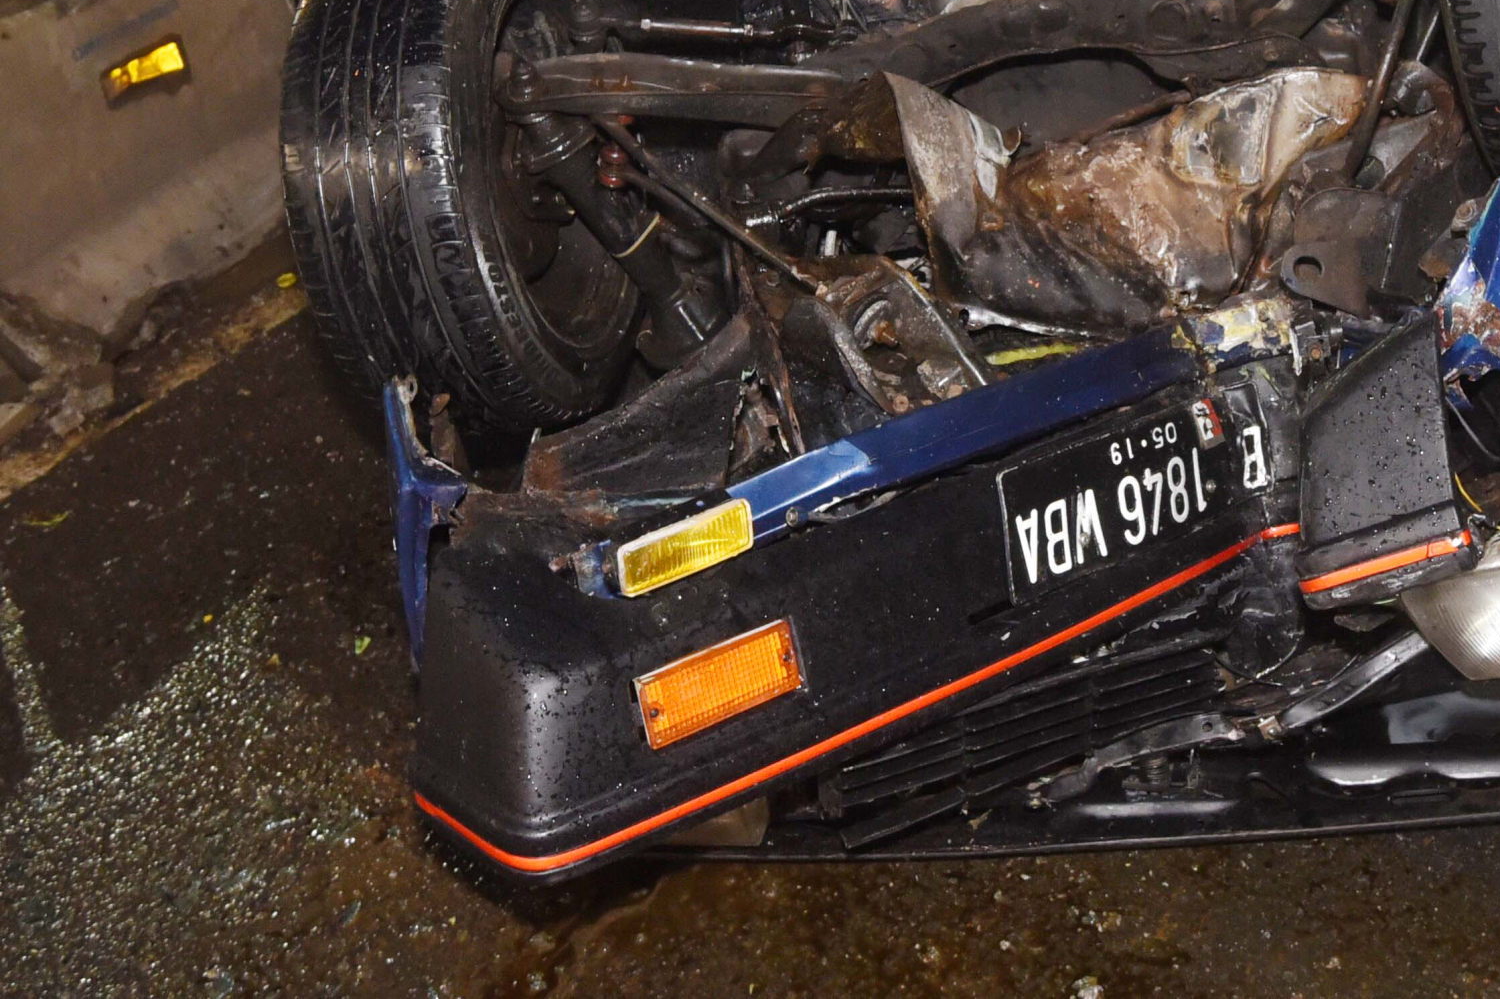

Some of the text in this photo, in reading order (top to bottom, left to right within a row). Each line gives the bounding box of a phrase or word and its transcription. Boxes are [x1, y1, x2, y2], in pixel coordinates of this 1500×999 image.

[1015, 424, 1269, 585] B 1846 WBA
